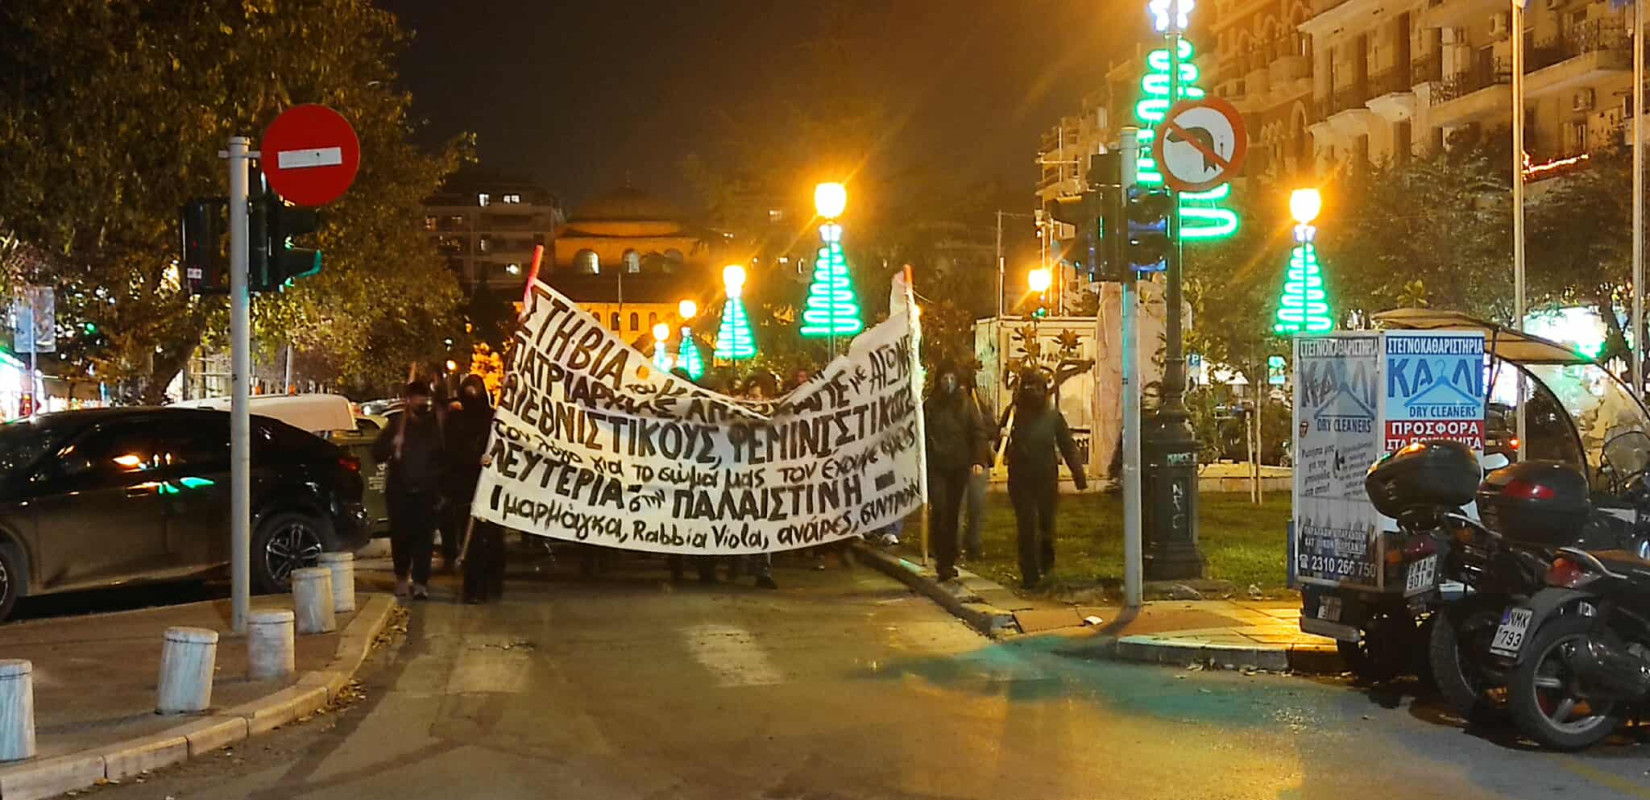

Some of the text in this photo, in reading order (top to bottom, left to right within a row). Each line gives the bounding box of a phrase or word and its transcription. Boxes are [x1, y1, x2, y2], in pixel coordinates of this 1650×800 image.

[1388, 338, 1484, 354] ΣΤΕΓΝΟΚΑΘΑΡΙΣΤΗΡΙΑ
[1191, 354, 1199, 365] P
[1409, 407, 1476, 418] DRY CLEANERS
[1392, 422, 1479, 435] ΠΡΟΣΦΟΡΑ
[672, 474, 862, 522] ΠΑΛΑΙΣΤΙΝΗ
[633, 521, 707, 549] Rabbia
[712, 522, 769, 550] Viola,
[1312, 556, 1377, 578] 2310 266 750
[1500, 630, 1522, 648] 793
